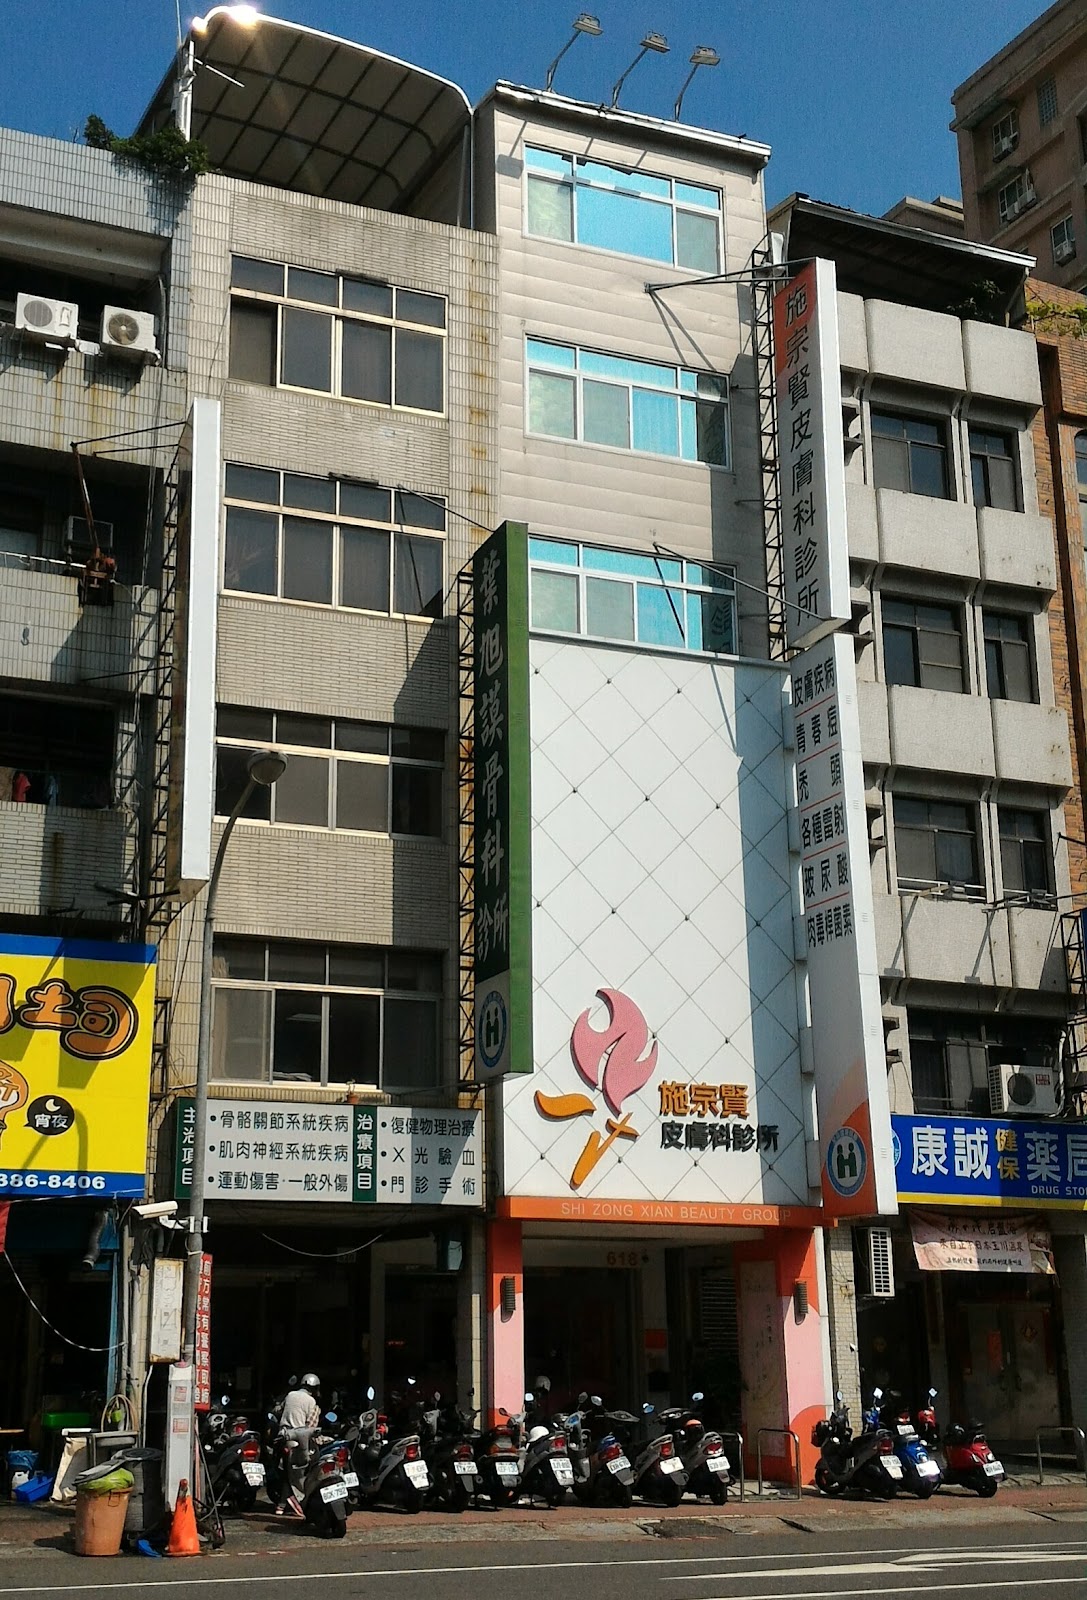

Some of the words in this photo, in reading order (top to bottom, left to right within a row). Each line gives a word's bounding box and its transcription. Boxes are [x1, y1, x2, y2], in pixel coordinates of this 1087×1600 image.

[784, 281, 819, 627] 施宗賢皮膚科診所
[794, 656, 835, 708] 皮膚疾病
[796, 705, 838, 754] 青春痘
[799, 753, 842, 802] 禿頭
[802, 801, 845, 849] 各種雷射
[804, 852, 849, 898] 玻尿酸
[807, 903, 852, 948] 肉毒桿菌素
[658, 1080, 750, 1120] 施宗賢
[34, 1113, 68, 1129] 宵夜
[220, 1110, 349, 1132] 骨骼關節系統疾病
[391, 1116, 475, 1137] 復健物理治療
[660, 1120, 779, 1152] 皮膚科診所
[218, 1140, 349, 1162] 肌肉神經系統疾病
[357, 1113, 373, 1190] 治療項目
[911, 1124, 991, 1180] 康誠
[995, 1127, 1020, 1180] 健保
[391, 1176, 475, 1195] 門診手術
[1031, 1185, 1059, 1195] DRUG
[1065, 1186, 1087, 1196] STO
[561, 1202, 585, 1215] SHI
[593, 1203, 634, 1217] ZONG
[640, 1205, 674, 1218] XIAN
[680, 1206, 736, 1220] BEAUTY
[742, 1208, 791, 1221] GROUP
[607, 1251, 638, 1266] 618
